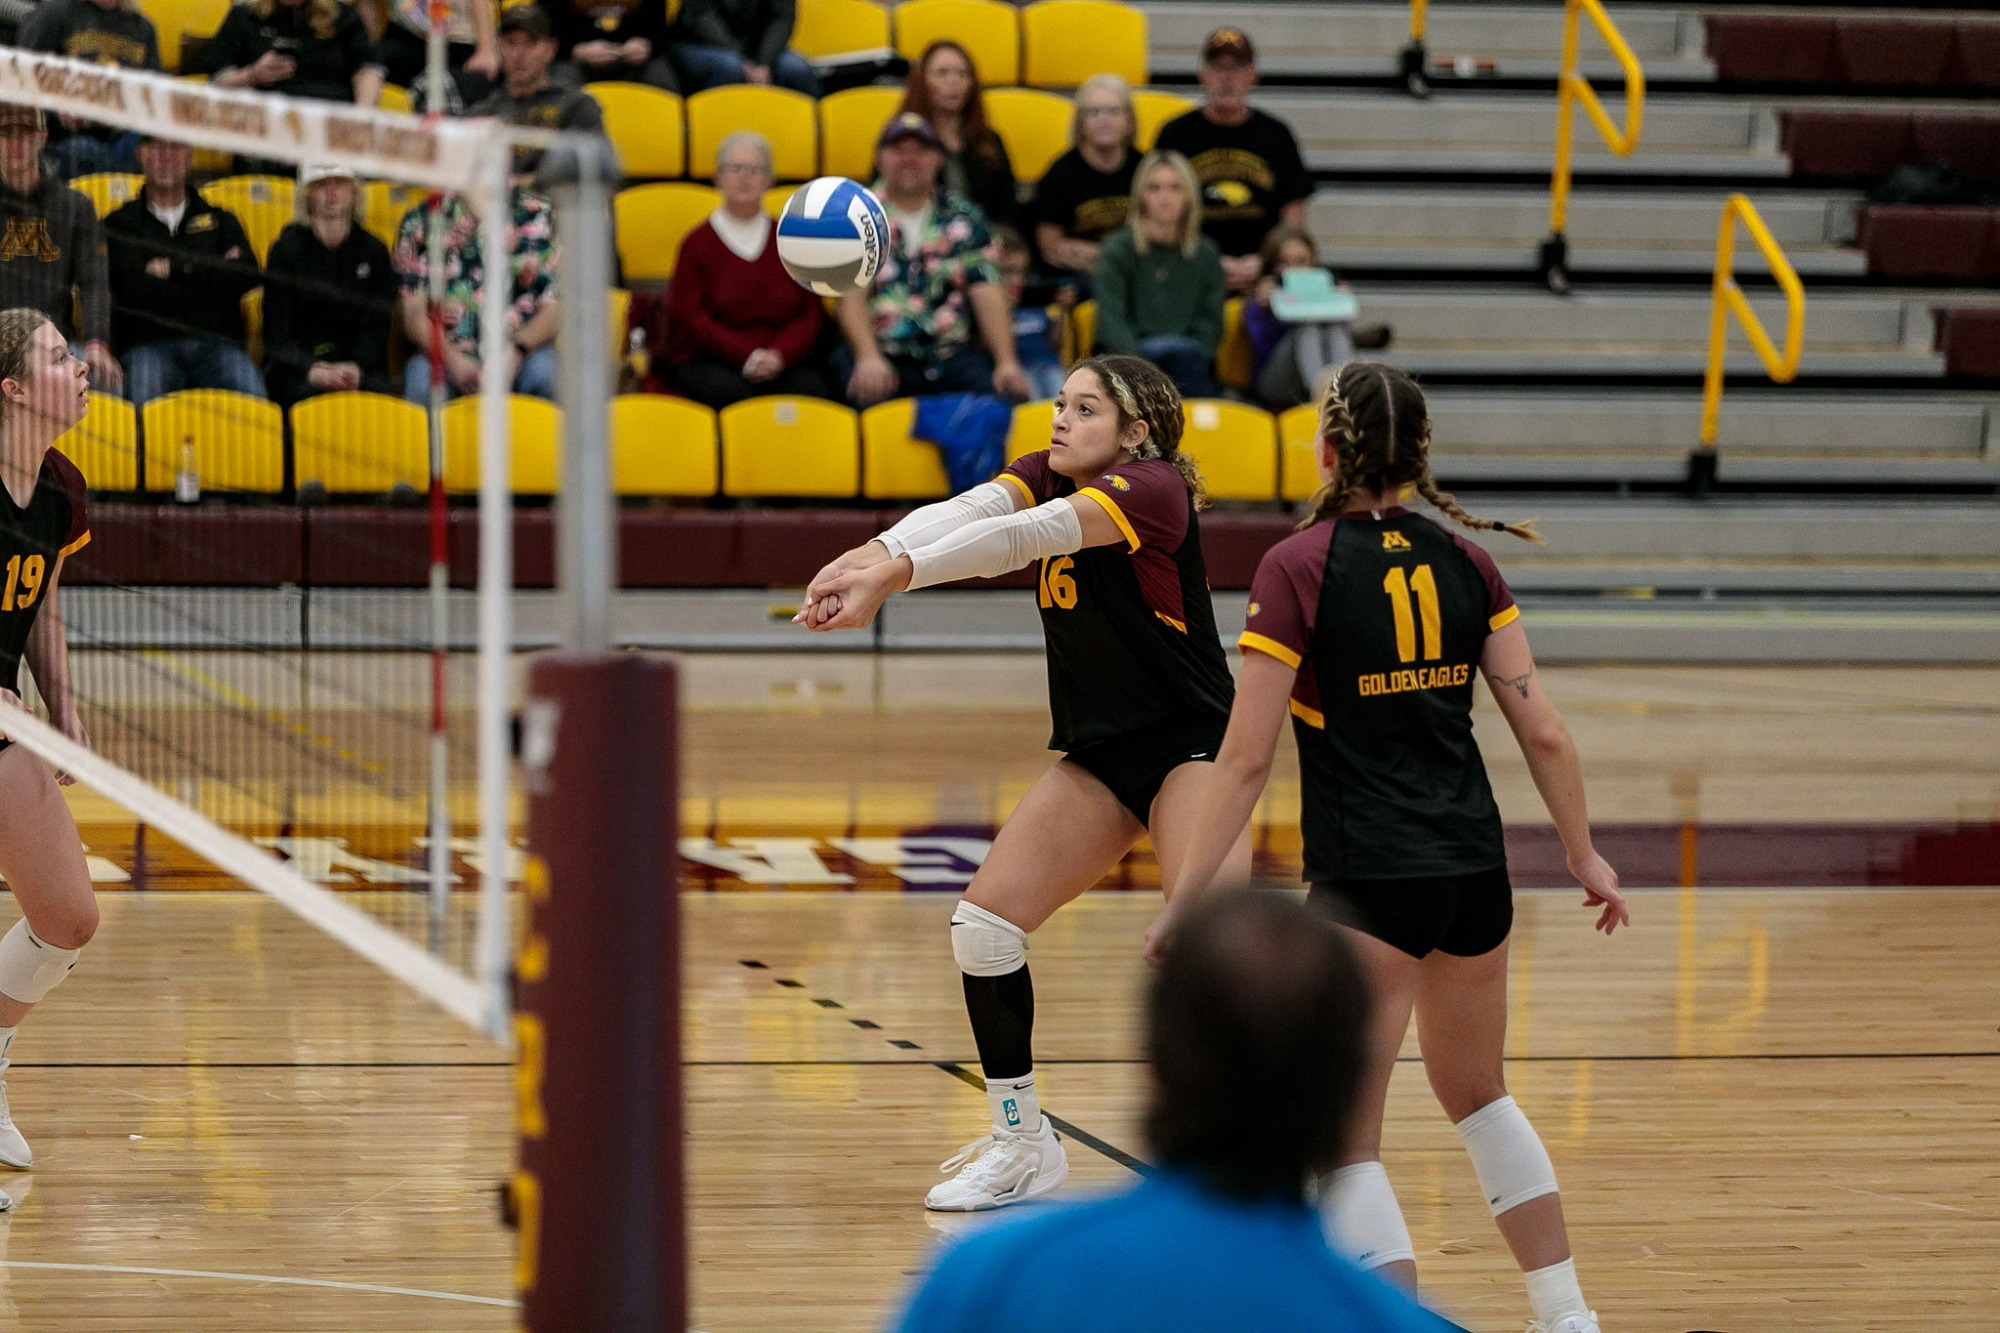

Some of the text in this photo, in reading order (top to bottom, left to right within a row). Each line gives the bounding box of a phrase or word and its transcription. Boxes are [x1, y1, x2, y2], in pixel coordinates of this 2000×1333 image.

[860, 213, 878, 278] molten
[1381, 530, 1412, 549] M
[2, 555, 45, 611] 19
[1040, 555, 1078, 609] 16
[1383, 564, 1442, 662] 11
